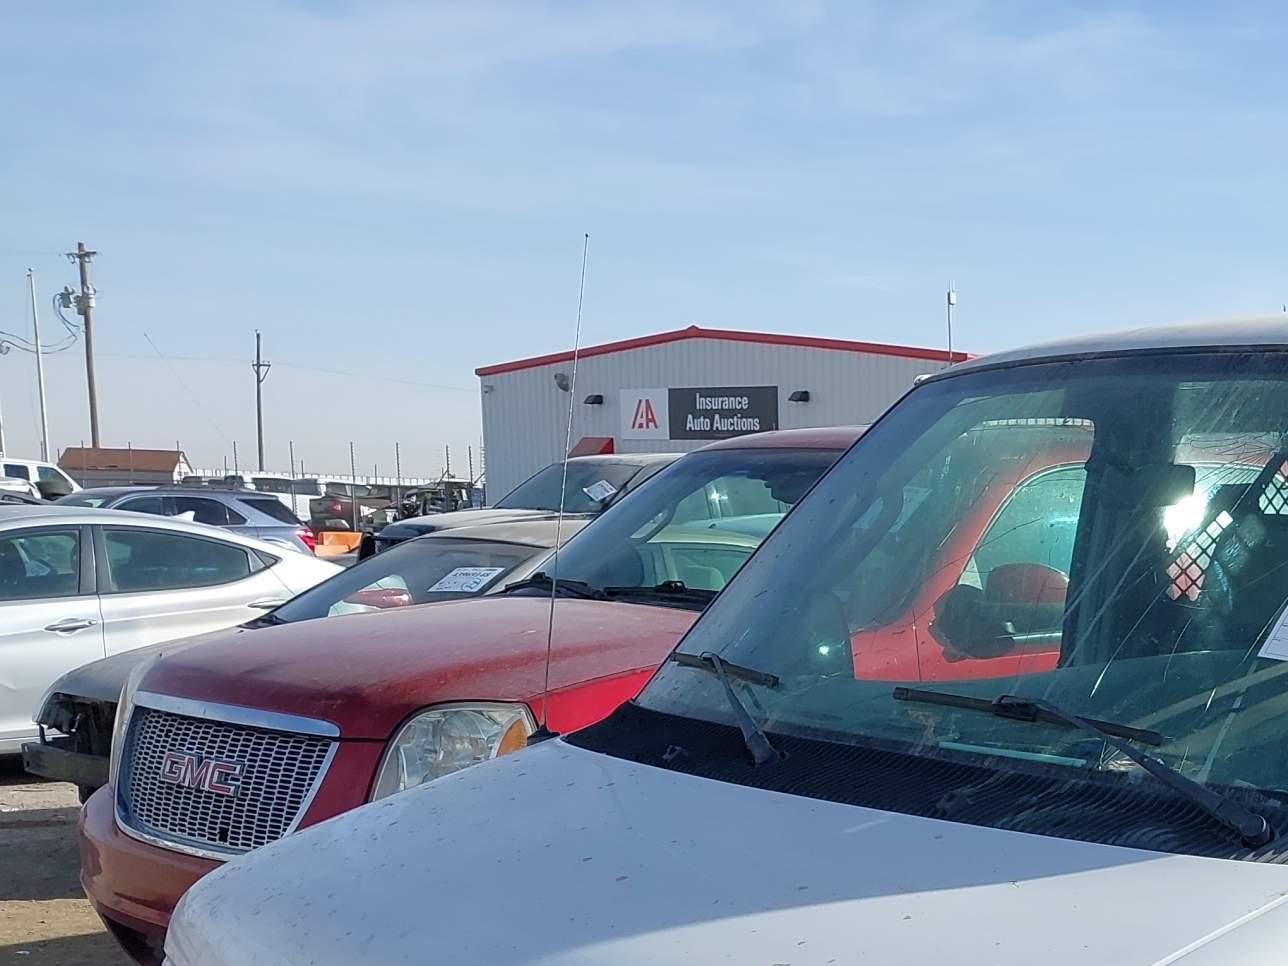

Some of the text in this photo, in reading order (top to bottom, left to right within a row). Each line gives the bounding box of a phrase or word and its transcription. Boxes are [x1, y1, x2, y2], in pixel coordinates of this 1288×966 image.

[695, 393, 749, 410] Insurance
[686, 414, 760, 431] Auto Auctions
[160, 750, 246, 797] GMC
